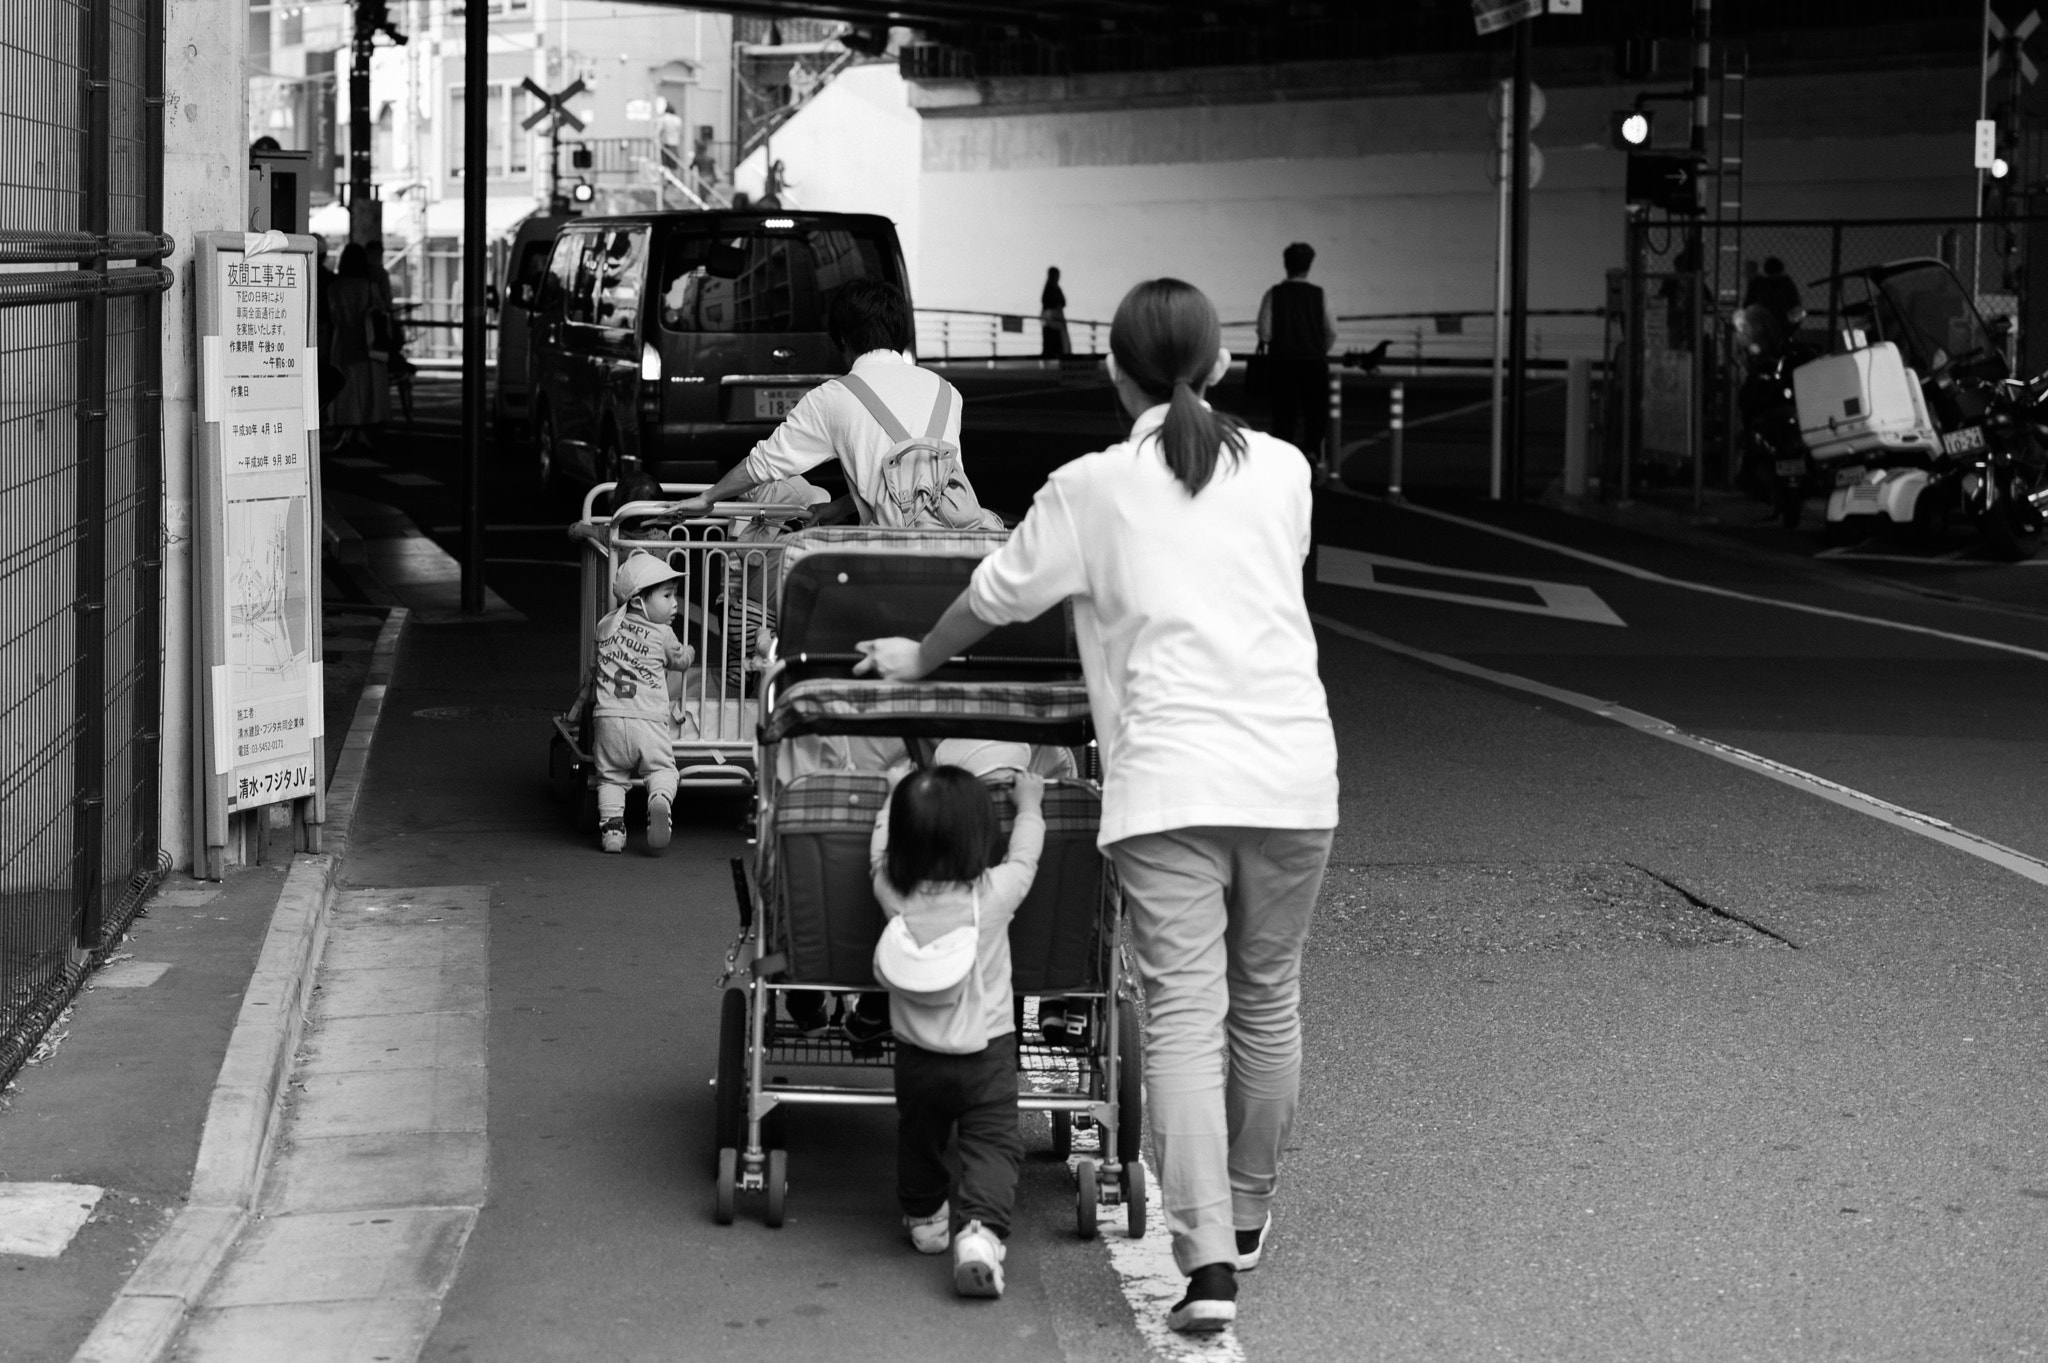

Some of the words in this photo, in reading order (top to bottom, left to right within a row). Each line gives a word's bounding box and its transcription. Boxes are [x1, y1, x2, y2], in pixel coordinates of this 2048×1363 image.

[228, 262, 297, 286] 夜間工事予告
[236, 290, 285, 303] 下記の日時により
[236, 306, 287, 319] 車両全面通行止め
[236, 323, 286, 336] を実施いたします。
[230, 340, 254, 353] 作業時間
[231, 385, 249, 397] 作業日
[232, 424, 258, 437] 平成30年
